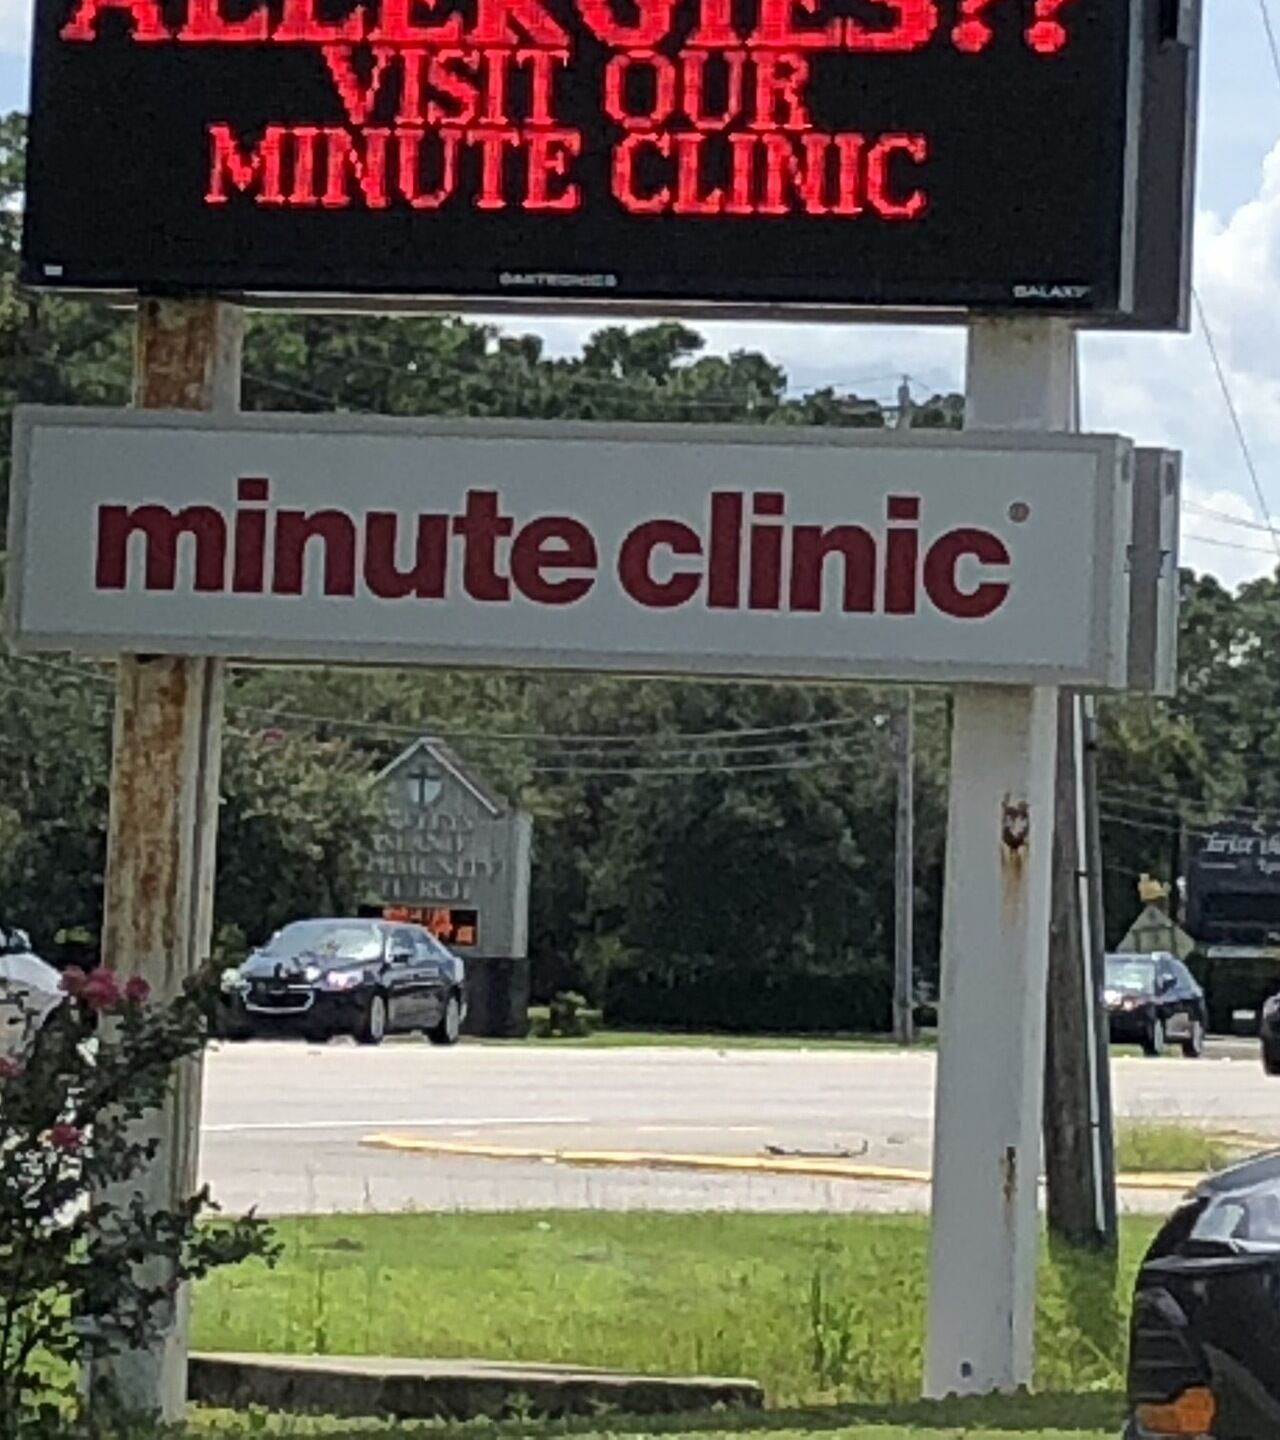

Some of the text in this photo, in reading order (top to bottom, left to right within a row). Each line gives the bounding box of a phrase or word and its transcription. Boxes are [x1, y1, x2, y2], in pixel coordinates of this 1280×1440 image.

[320, 45, 812, 131] VISIT OUR
[203, 124, 927, 219] MINUTE CLINIC
[95, 478, 1011, 620] minute clinic
